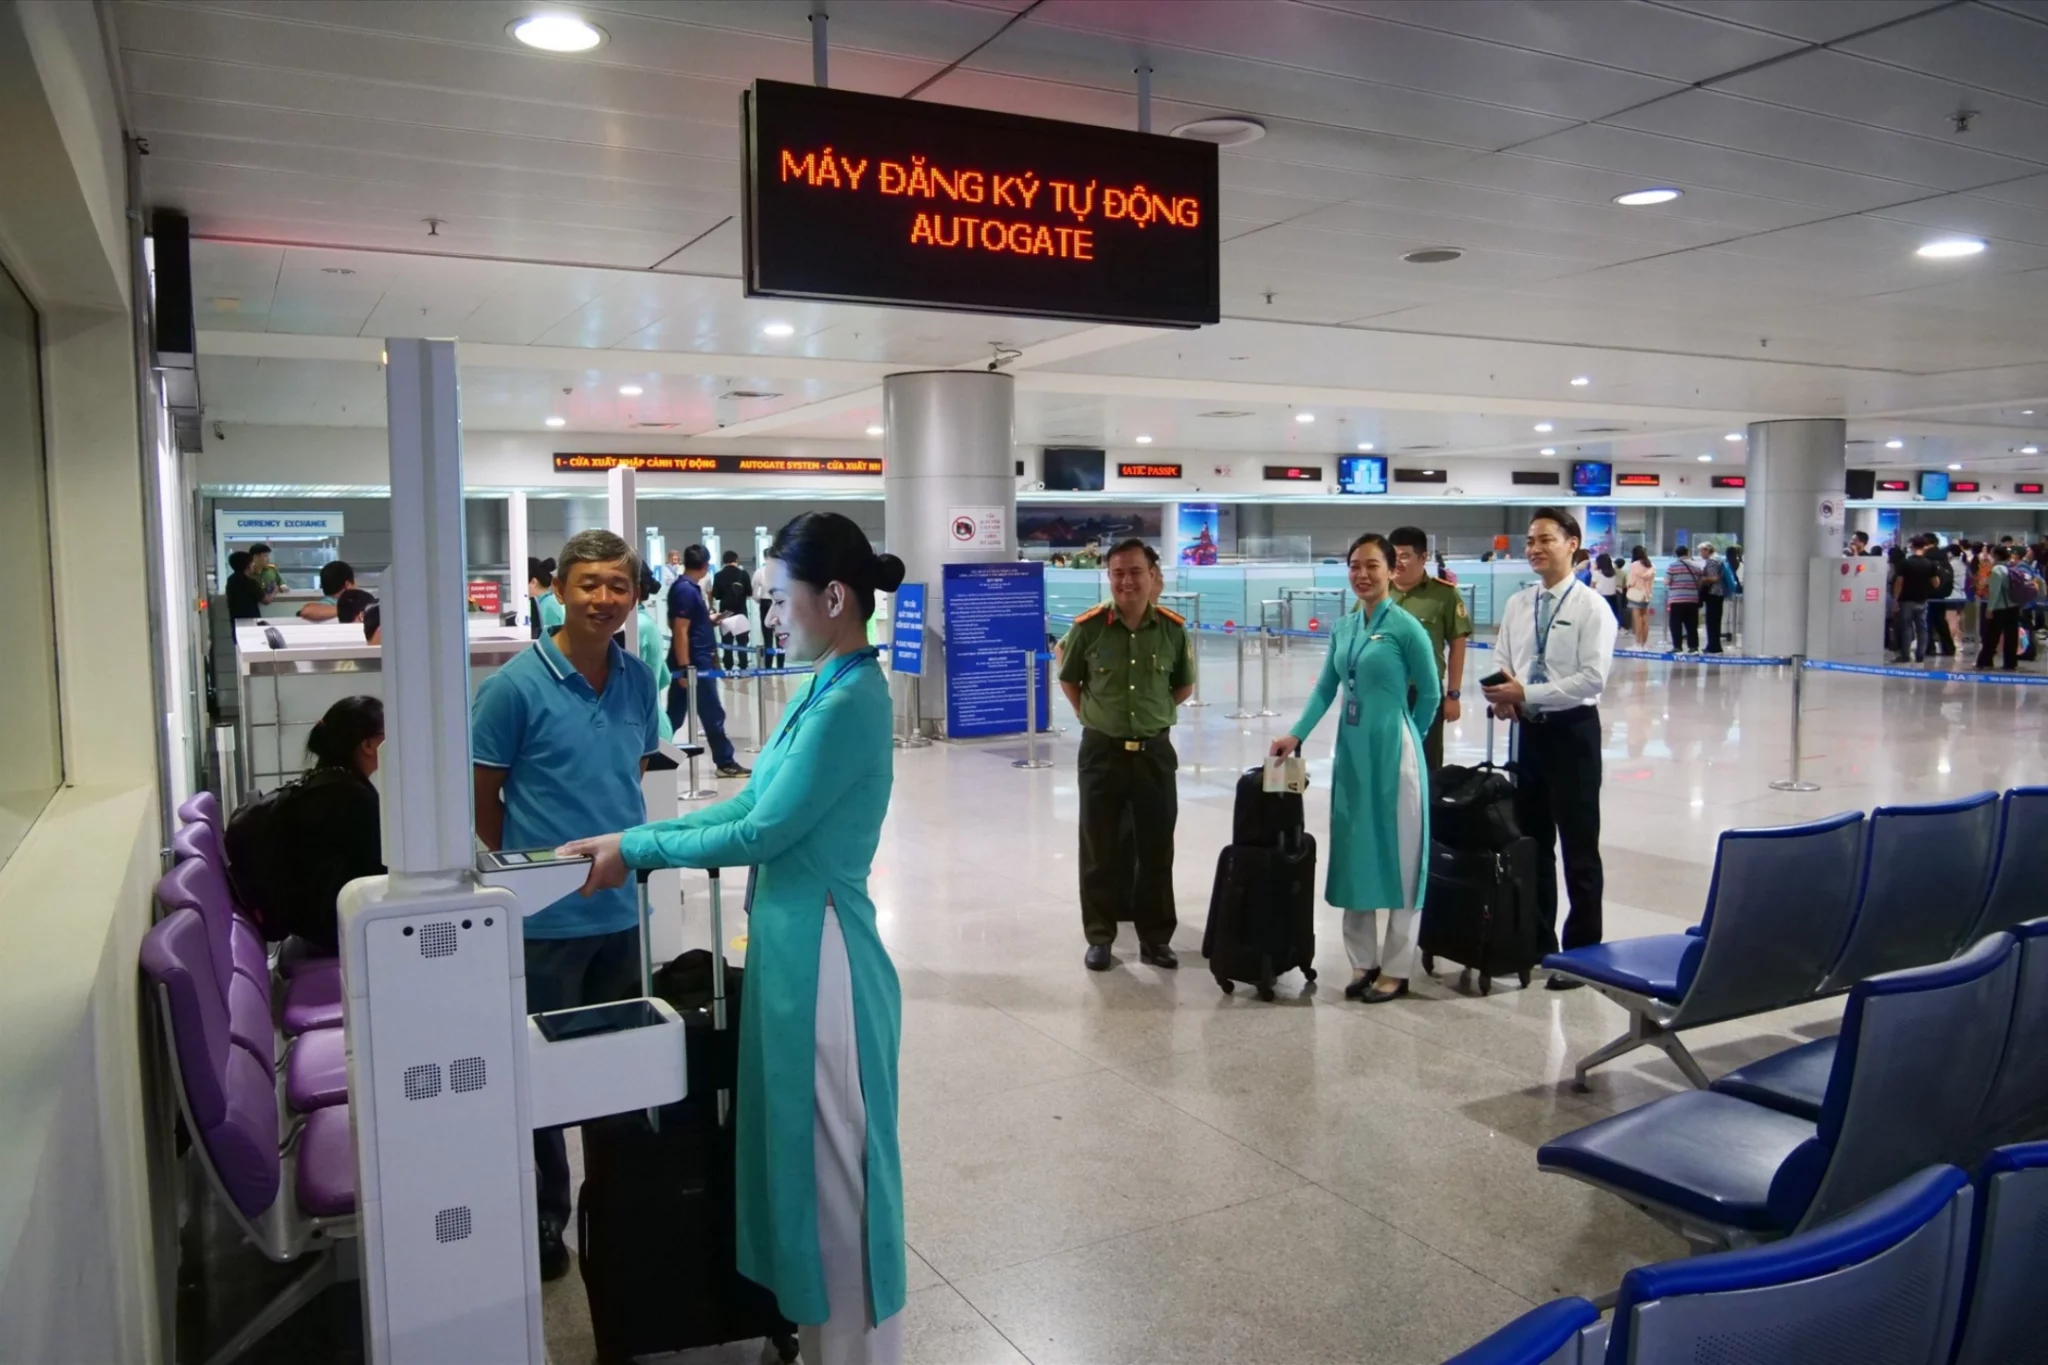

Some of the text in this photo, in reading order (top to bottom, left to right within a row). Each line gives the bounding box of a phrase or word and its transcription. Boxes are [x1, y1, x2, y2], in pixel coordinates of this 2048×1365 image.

[780, 147, 1200, 228] MÁY ĐĂNG KÝ TỰ ĐỘNG
[910, 213, 1093, 260] AUTOGATE
[569, 455, 589, 467] CỬA
[592, 456, 617, 467] XUẤT
[647, 457, 672, 468] CẢNH
[674, 458, 688, 469] TỰ
[689, 458, 716, 470] ĐỘNG
[739, 459, 785, 470] AUTOGATE
[787, 460, 819, 470] SYSTEM
[827, 459, 844, 470] CỬA
[846, 460, 867, 470] XUẤT
[237, 519, 327, 528] CURRENCY EXCHANGE
[1947, 673, 1966, 681] TIA
